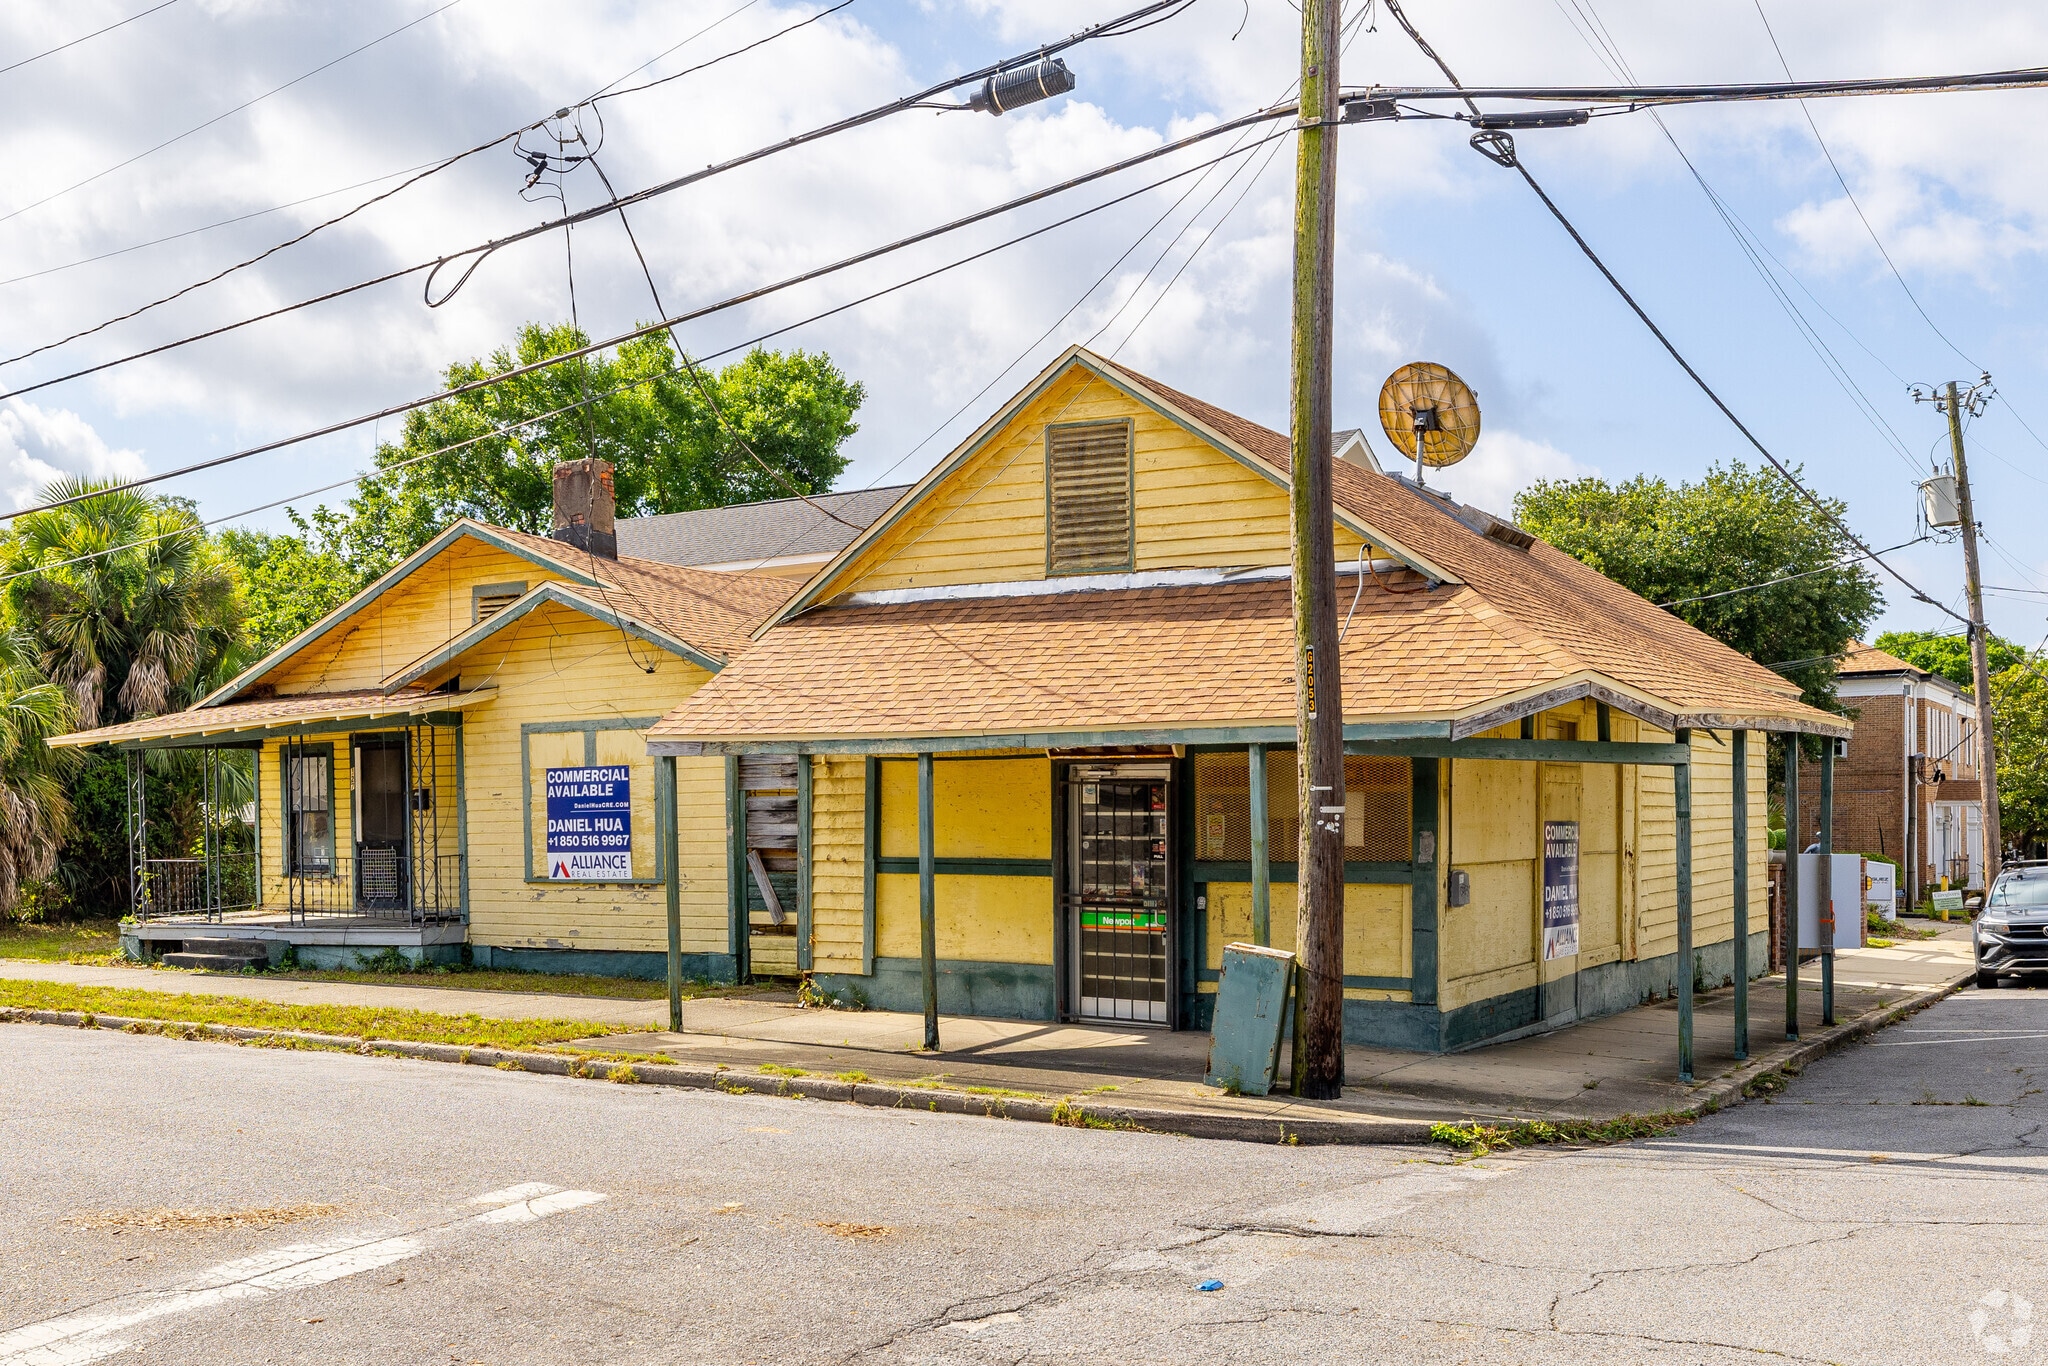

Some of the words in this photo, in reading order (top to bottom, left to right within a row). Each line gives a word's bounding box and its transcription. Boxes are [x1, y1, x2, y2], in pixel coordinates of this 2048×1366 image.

[547, 768, 629, 783] COMMERCIAL
[547, 784, 613, 798] AVAILABLE
[548, 818, 592, 833] DANIEL
[594, 817, 623, 832] HUA
[581, 835, 600, 846] 516
[601, 834, 630, 846] 9967
[571, 855, 626, 869] ALLIANCE
[571, 869, 592, 878] REAL
[597, 870, 628, 878] ESTATE
[1545, 885, 1568, 902] DANIEL
